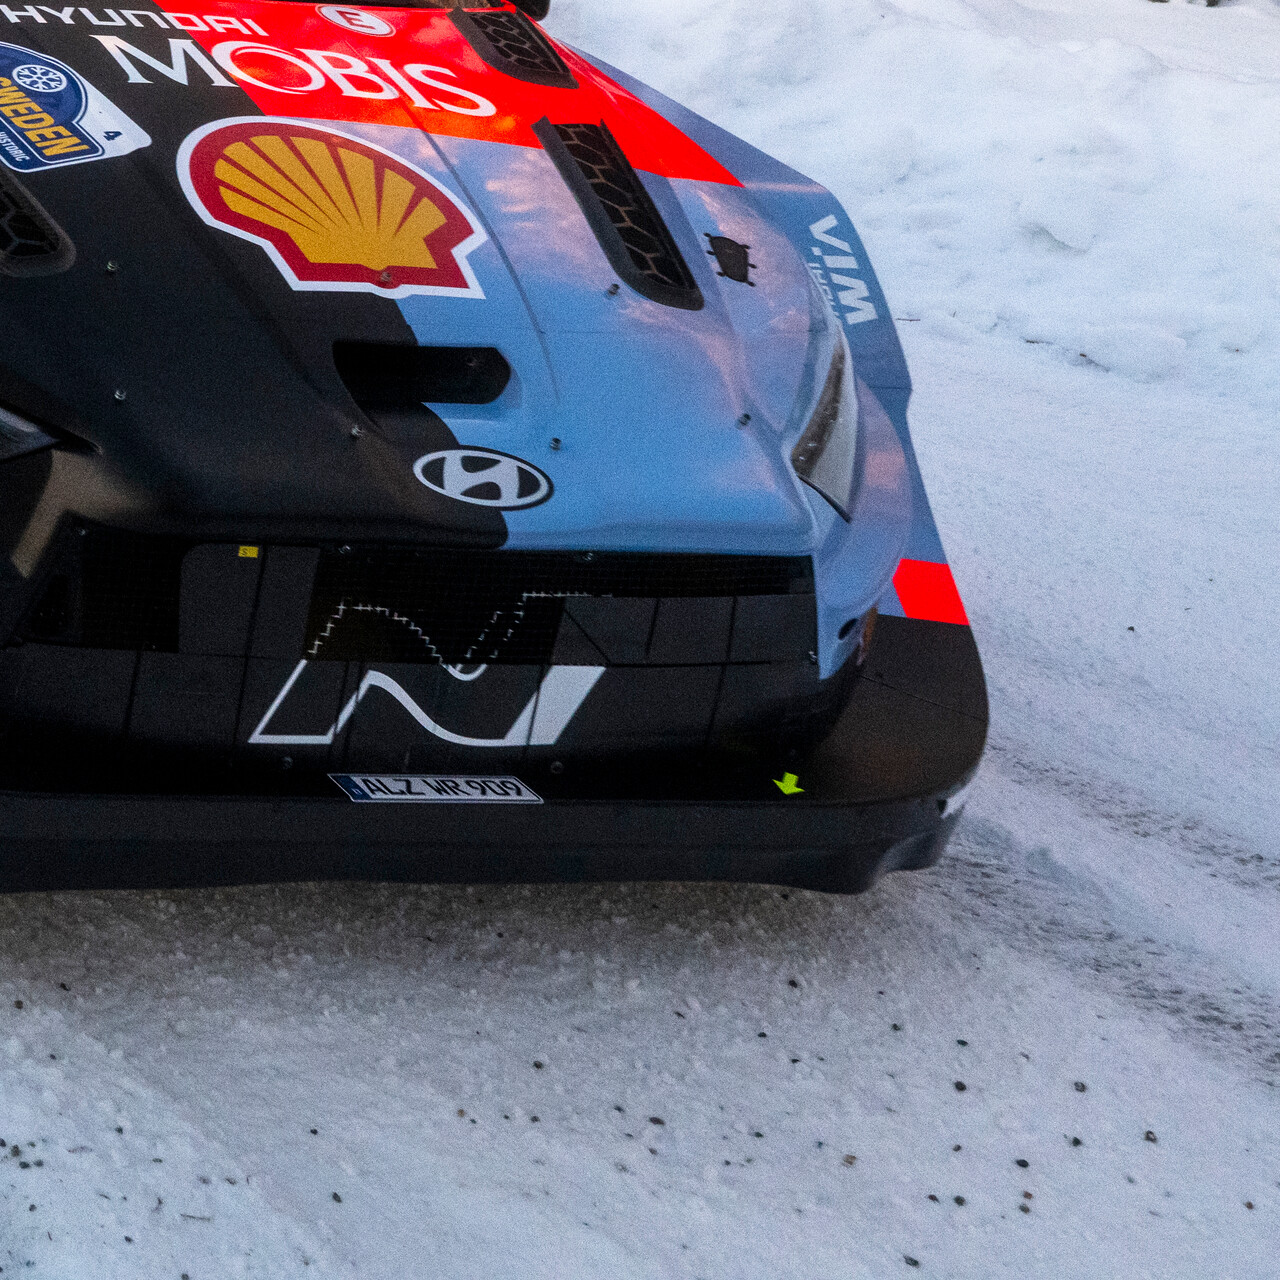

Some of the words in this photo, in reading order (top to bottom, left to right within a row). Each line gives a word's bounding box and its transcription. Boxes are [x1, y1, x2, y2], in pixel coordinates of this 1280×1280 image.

[89, 34, 496, 117] MOBIS
[103, 131, 122, 141] 4
[361, 778, 425, 796] ALZ
